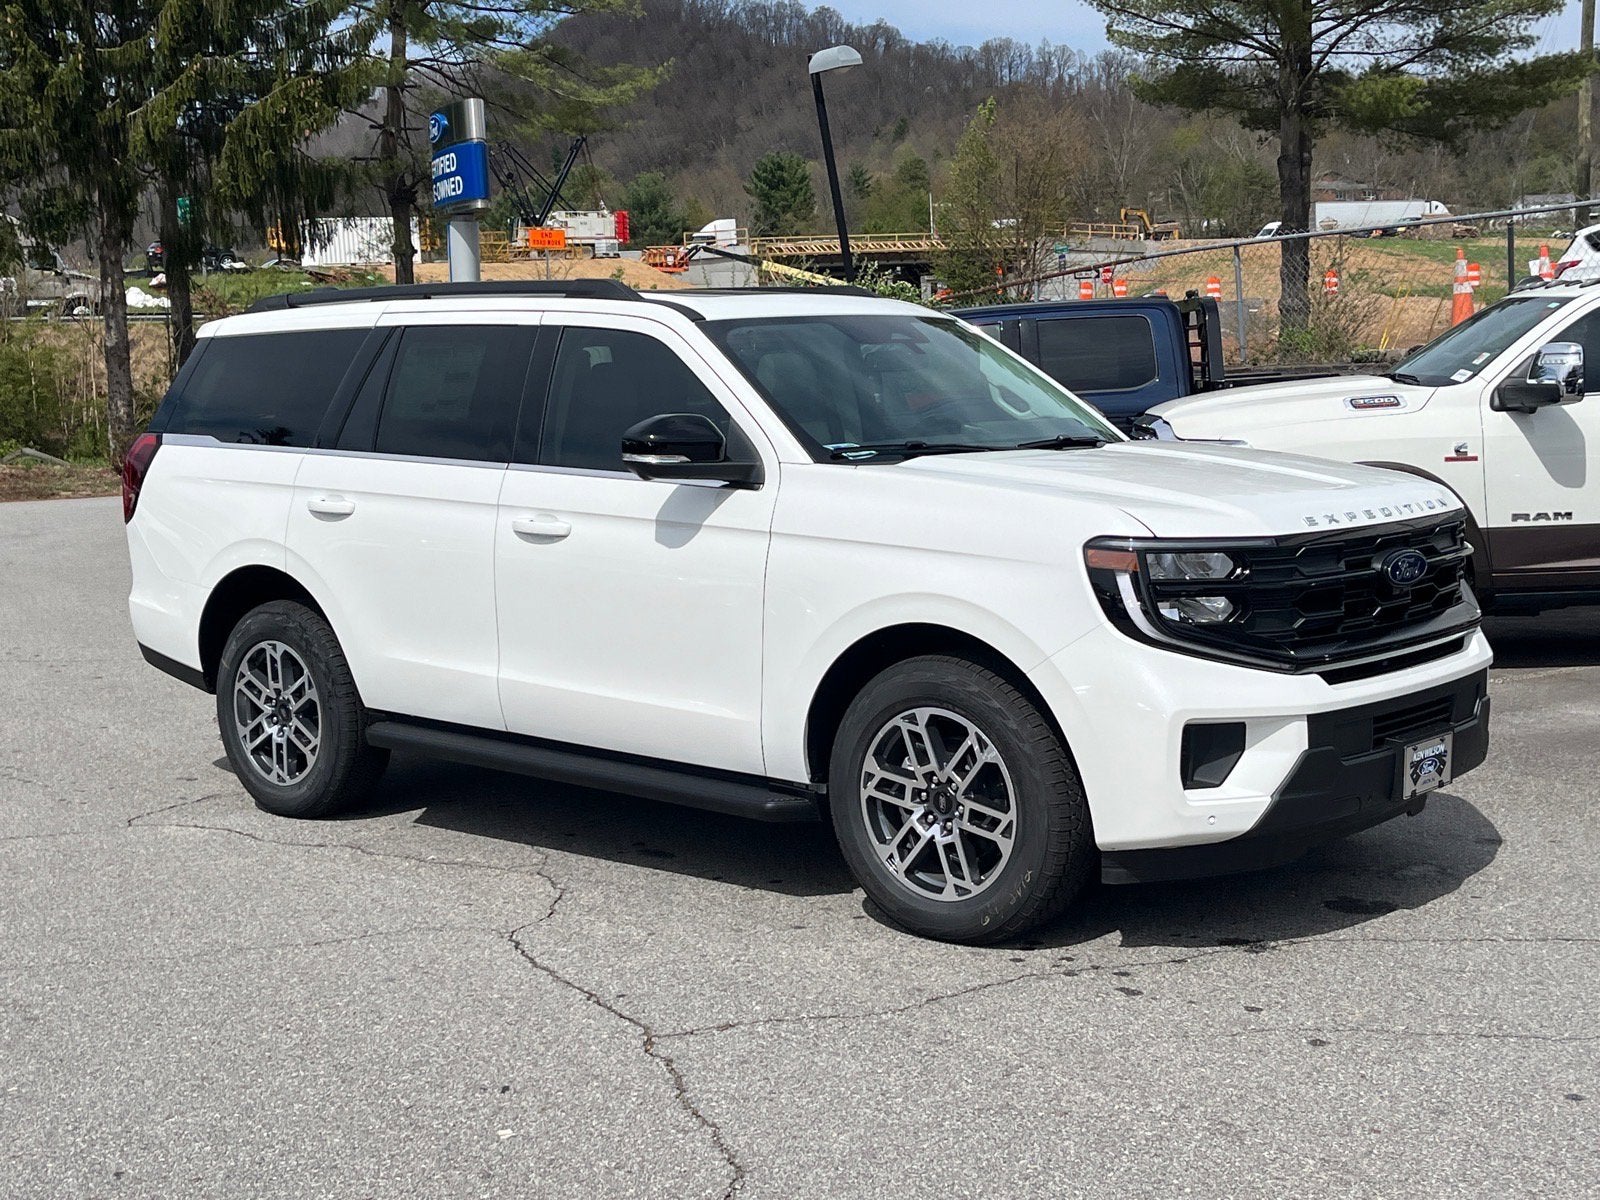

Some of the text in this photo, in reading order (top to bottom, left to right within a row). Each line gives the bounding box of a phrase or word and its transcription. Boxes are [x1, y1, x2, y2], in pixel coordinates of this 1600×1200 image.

[540, 231, 553, 239] END
[1302, 498, 1448, 527] EXPEDITION
[1511, 511, 1573, 523] RAM
